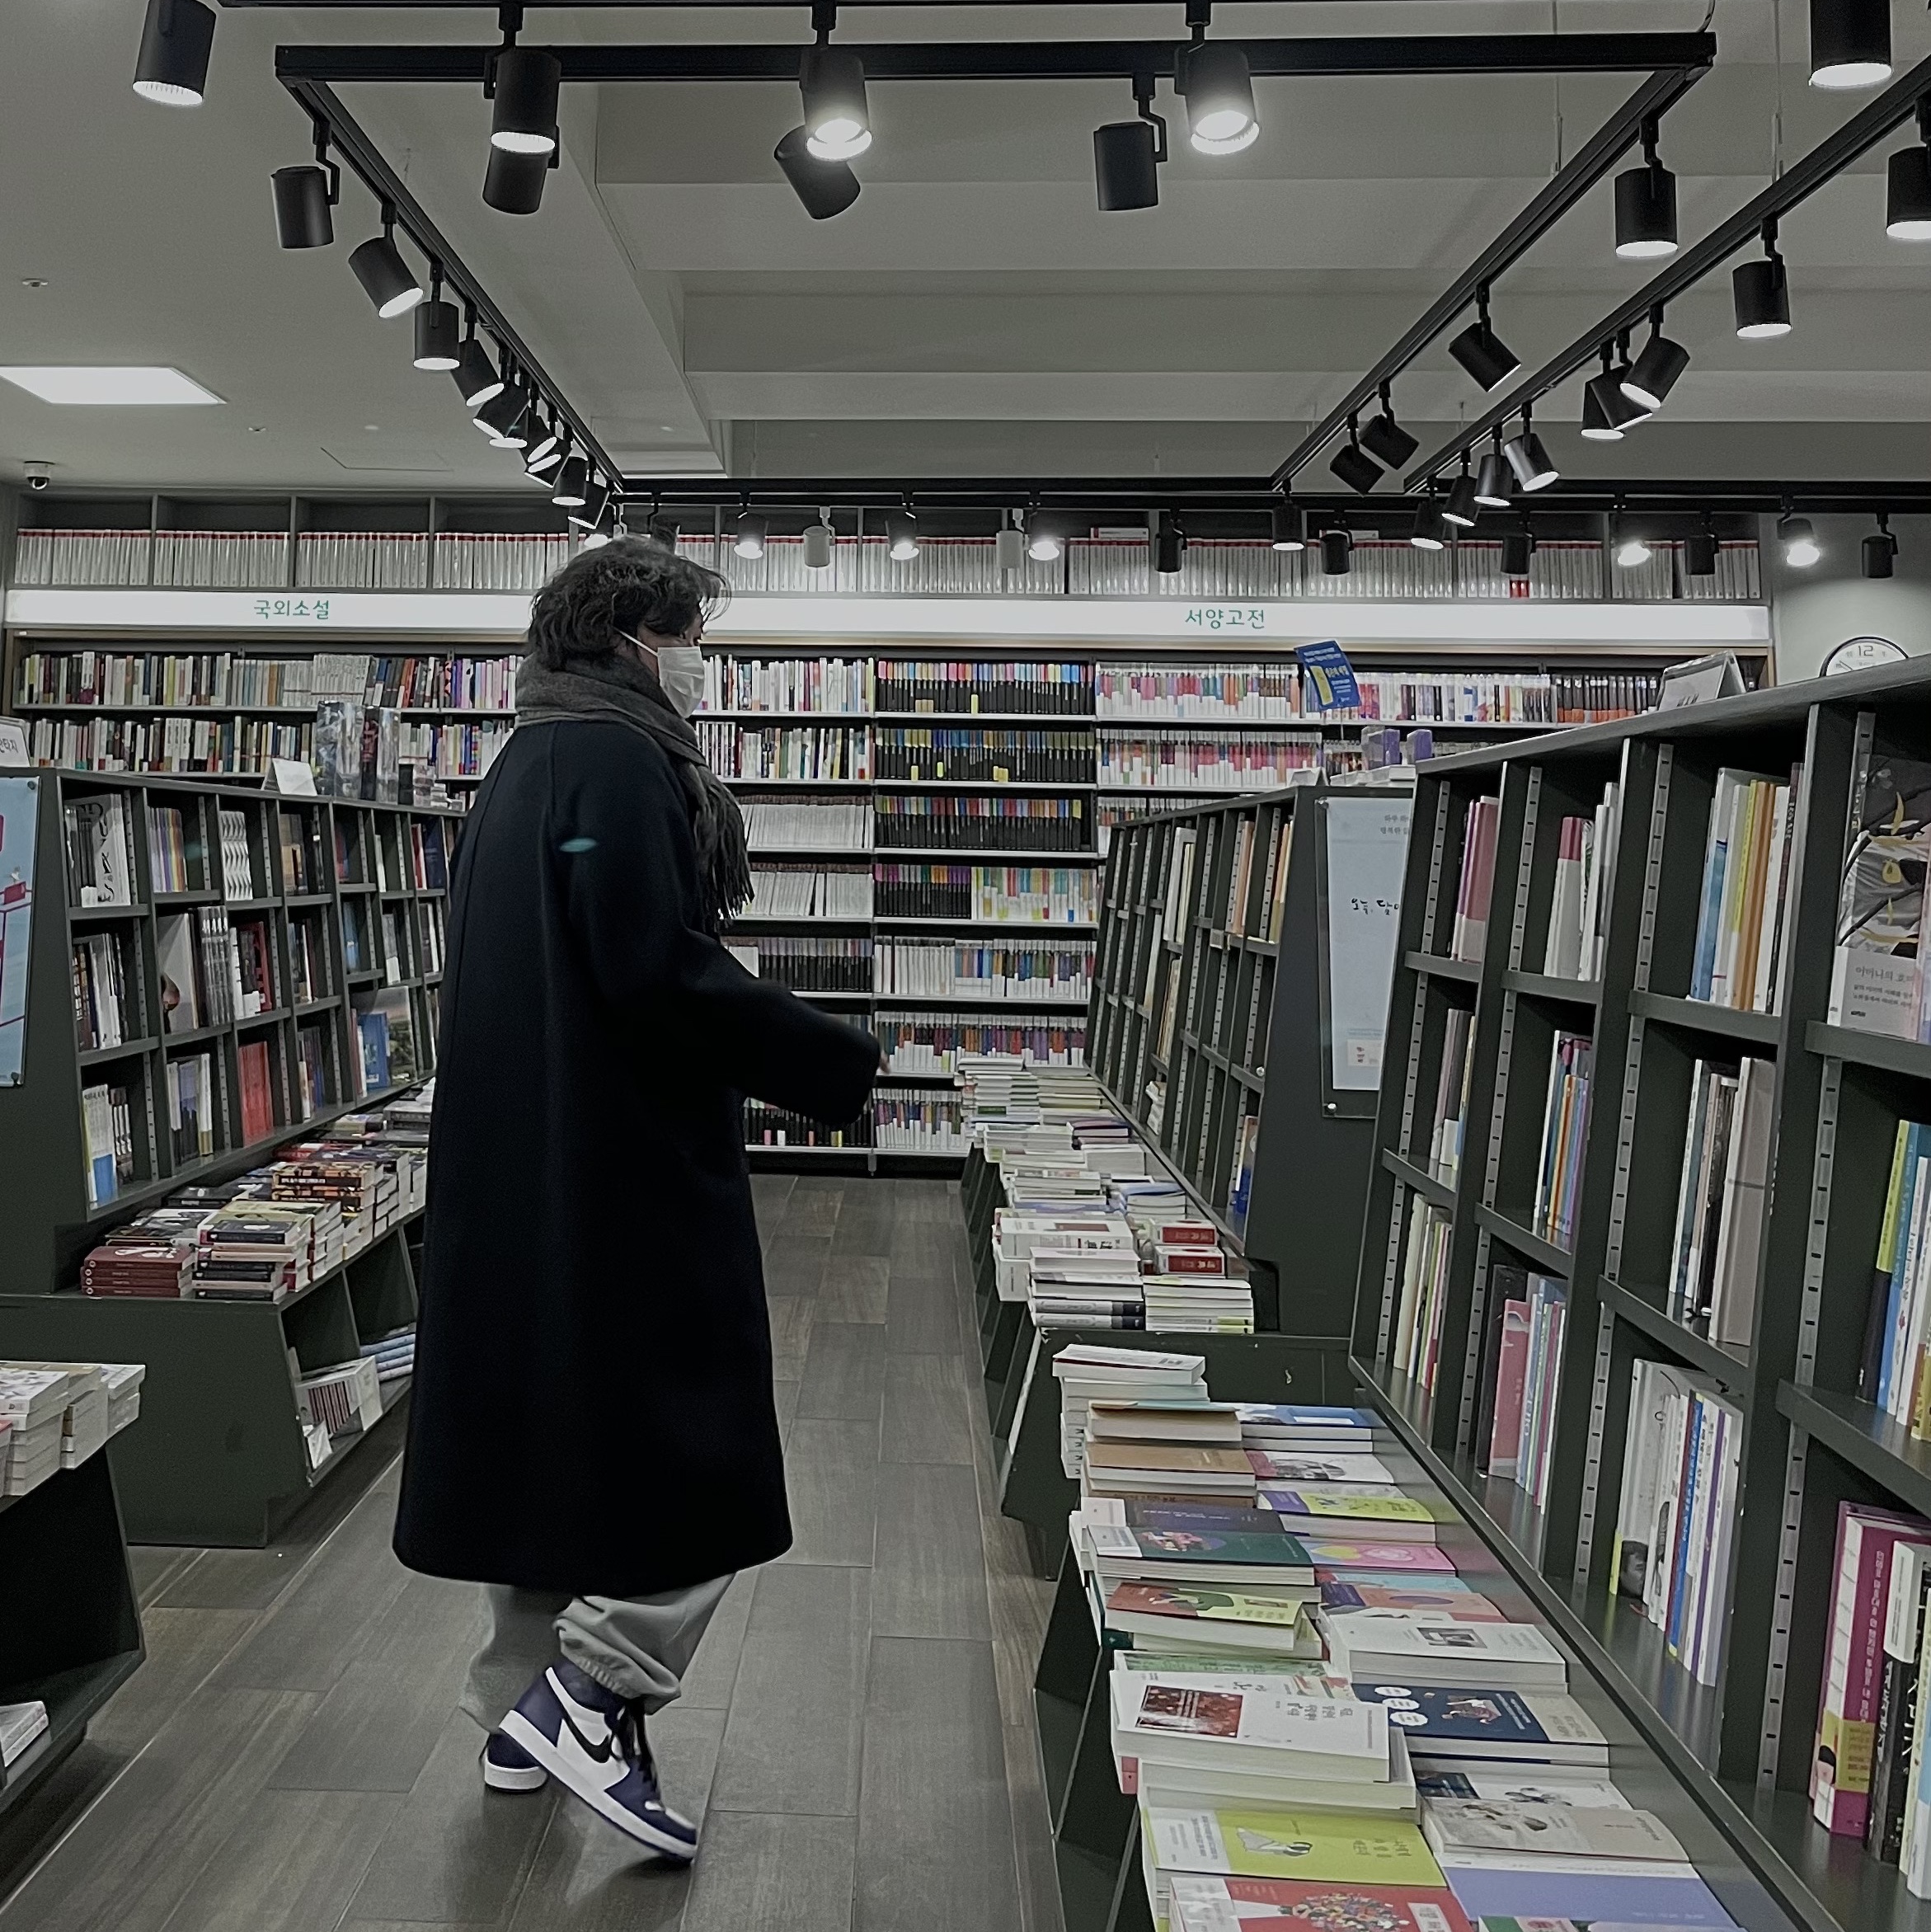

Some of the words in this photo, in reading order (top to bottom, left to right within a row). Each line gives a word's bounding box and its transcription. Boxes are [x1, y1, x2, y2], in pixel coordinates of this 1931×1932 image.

[254, 599, 329, 620] 국외소설
[1185, 609, 1265, 629] 서양고전
[1858, 645, 1873, 657] 12
